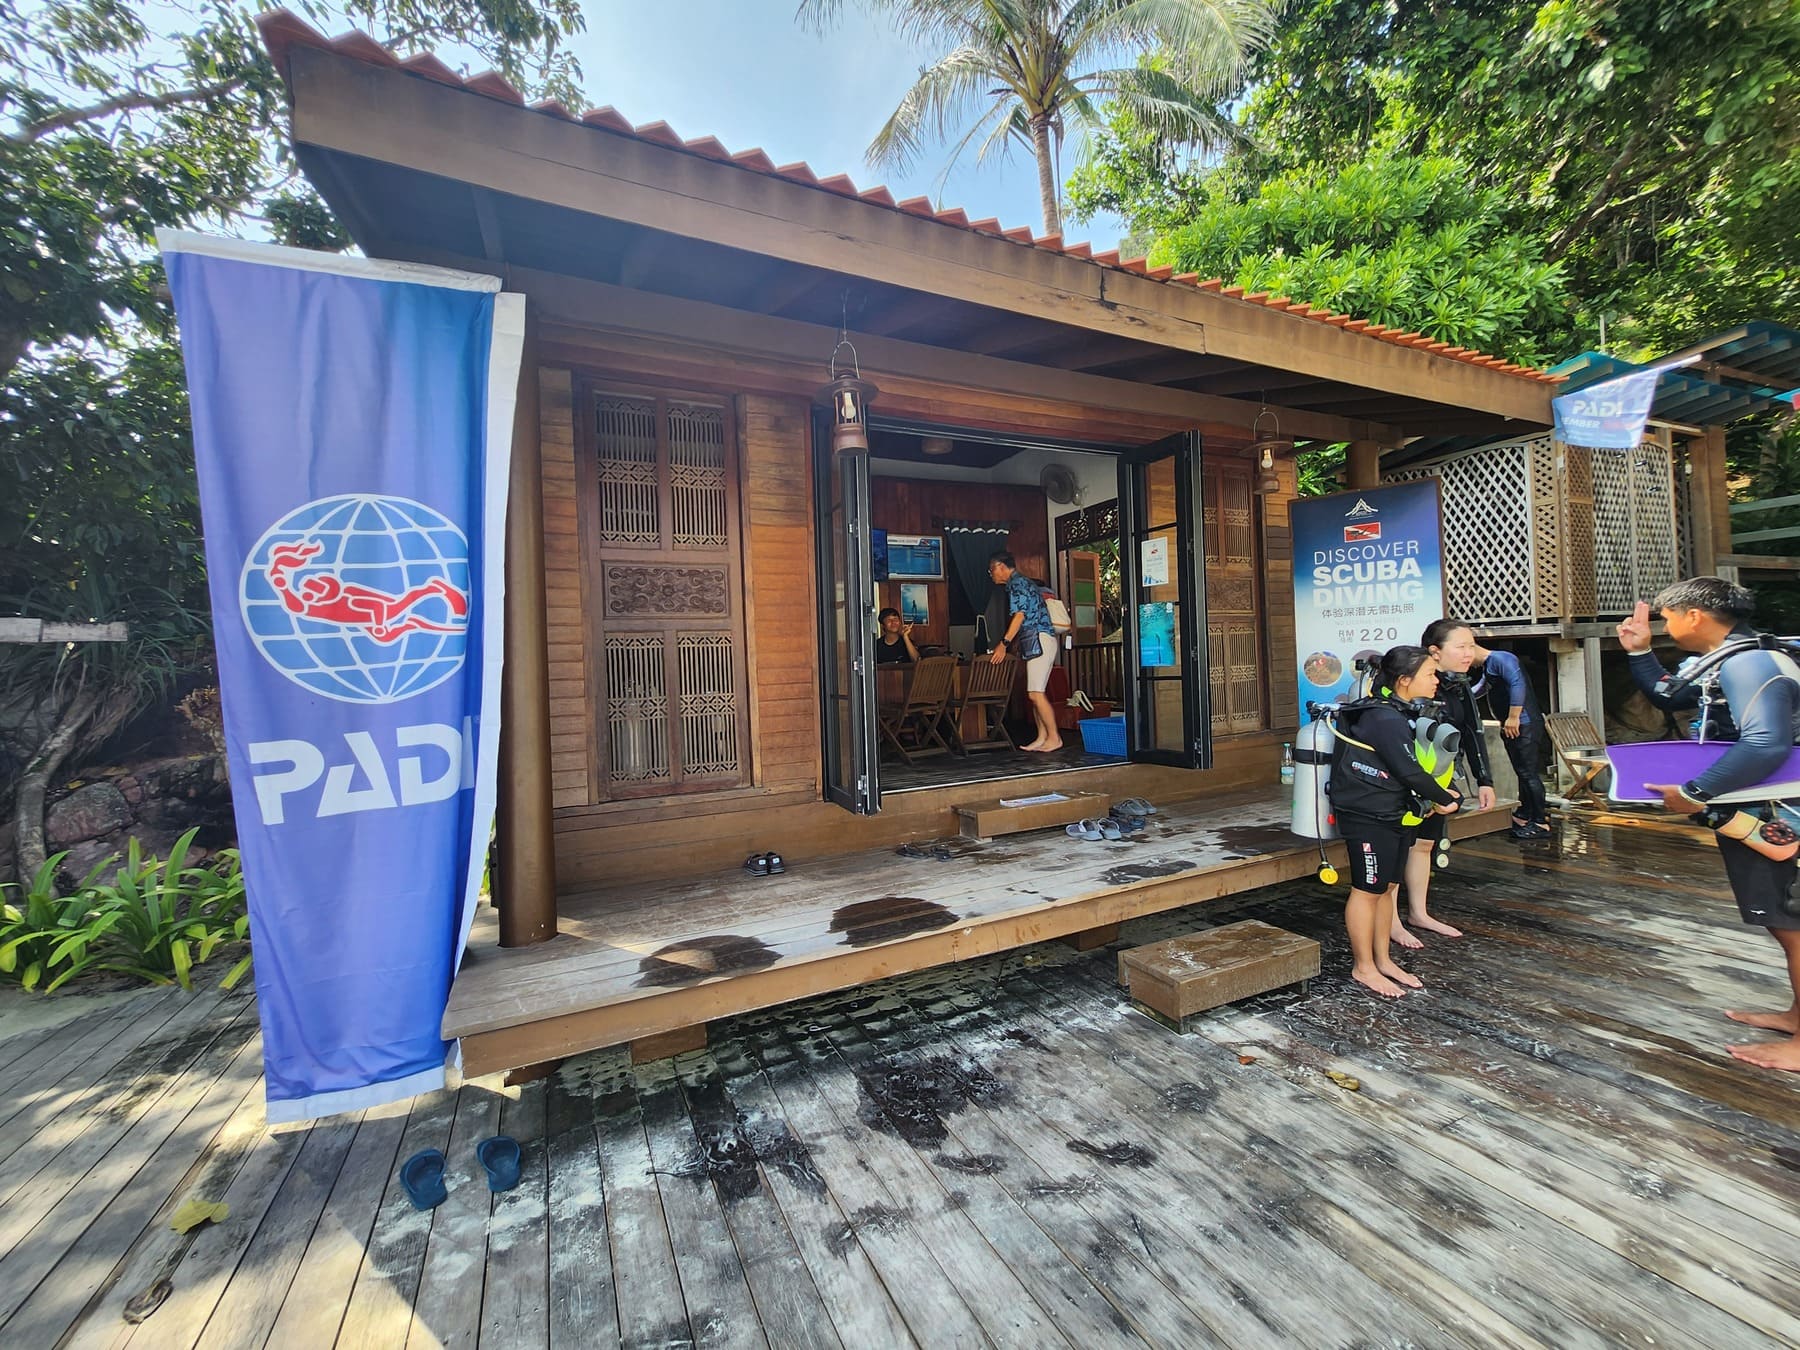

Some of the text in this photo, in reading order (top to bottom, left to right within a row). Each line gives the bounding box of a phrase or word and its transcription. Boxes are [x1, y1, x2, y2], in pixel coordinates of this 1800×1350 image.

[1572, 399, 1624, 418] PADI
[1314, 540, 1420, 566] DISCOVER
[1313, 557, 1422, 587] SCUBA
[1313, 580, 1424, 608] DIVING
[1321, 603, 1415, 618] 体验深潜无需执照
[1338, 629, 1355, 638] RM
[1360, 627, 1398, 642] 220
[248, 715, 475, 826] PADI
[1364, 854, 1375, 885] mares
